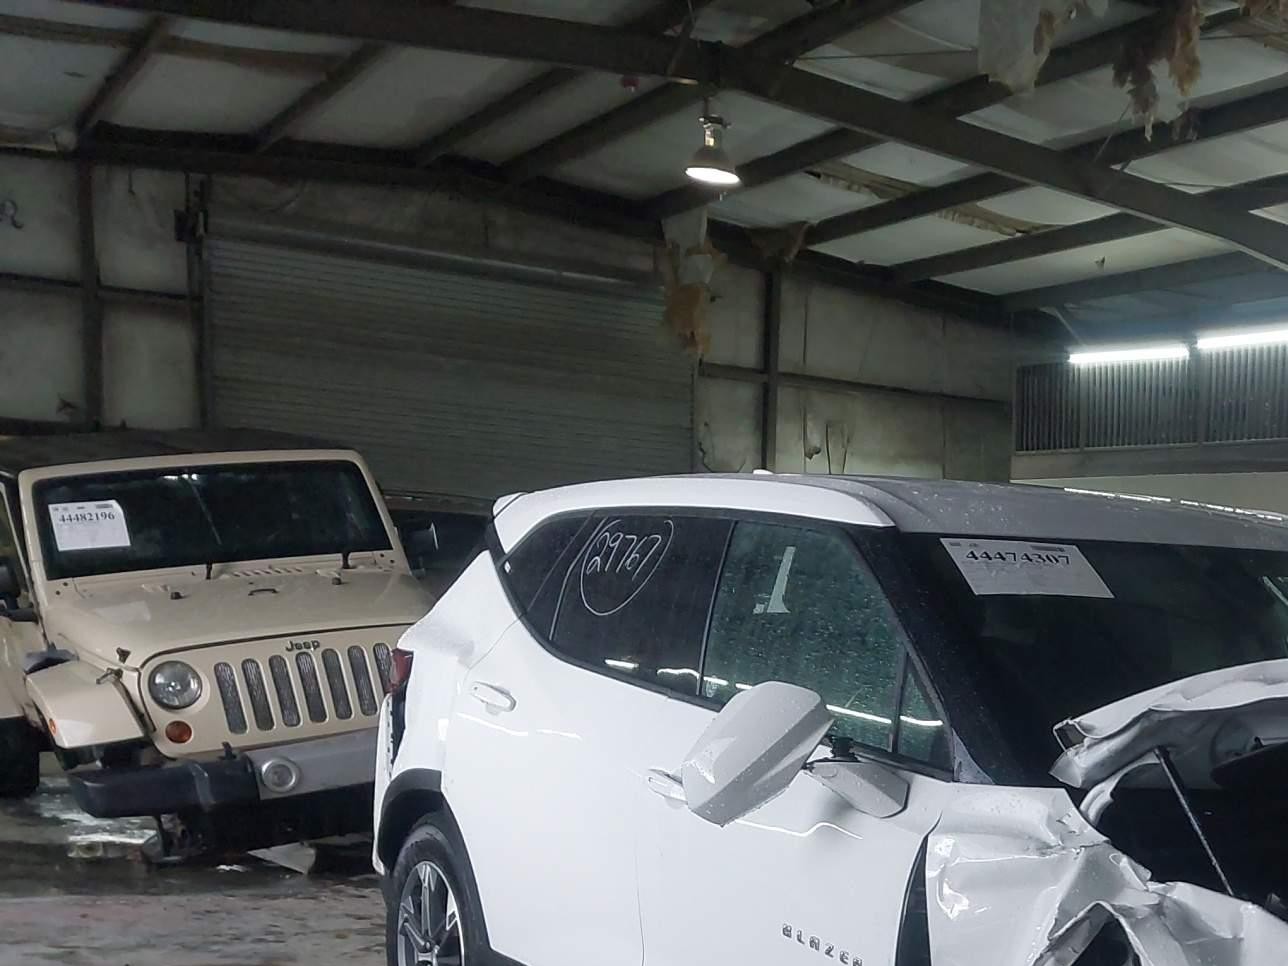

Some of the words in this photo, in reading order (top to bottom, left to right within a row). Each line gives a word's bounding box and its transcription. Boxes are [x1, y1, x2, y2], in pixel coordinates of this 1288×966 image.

[59, 511, 115, 523] 44482196
[966, 549, 1070, 565] 44474307
[285, 640, 321, 652] Jeep
